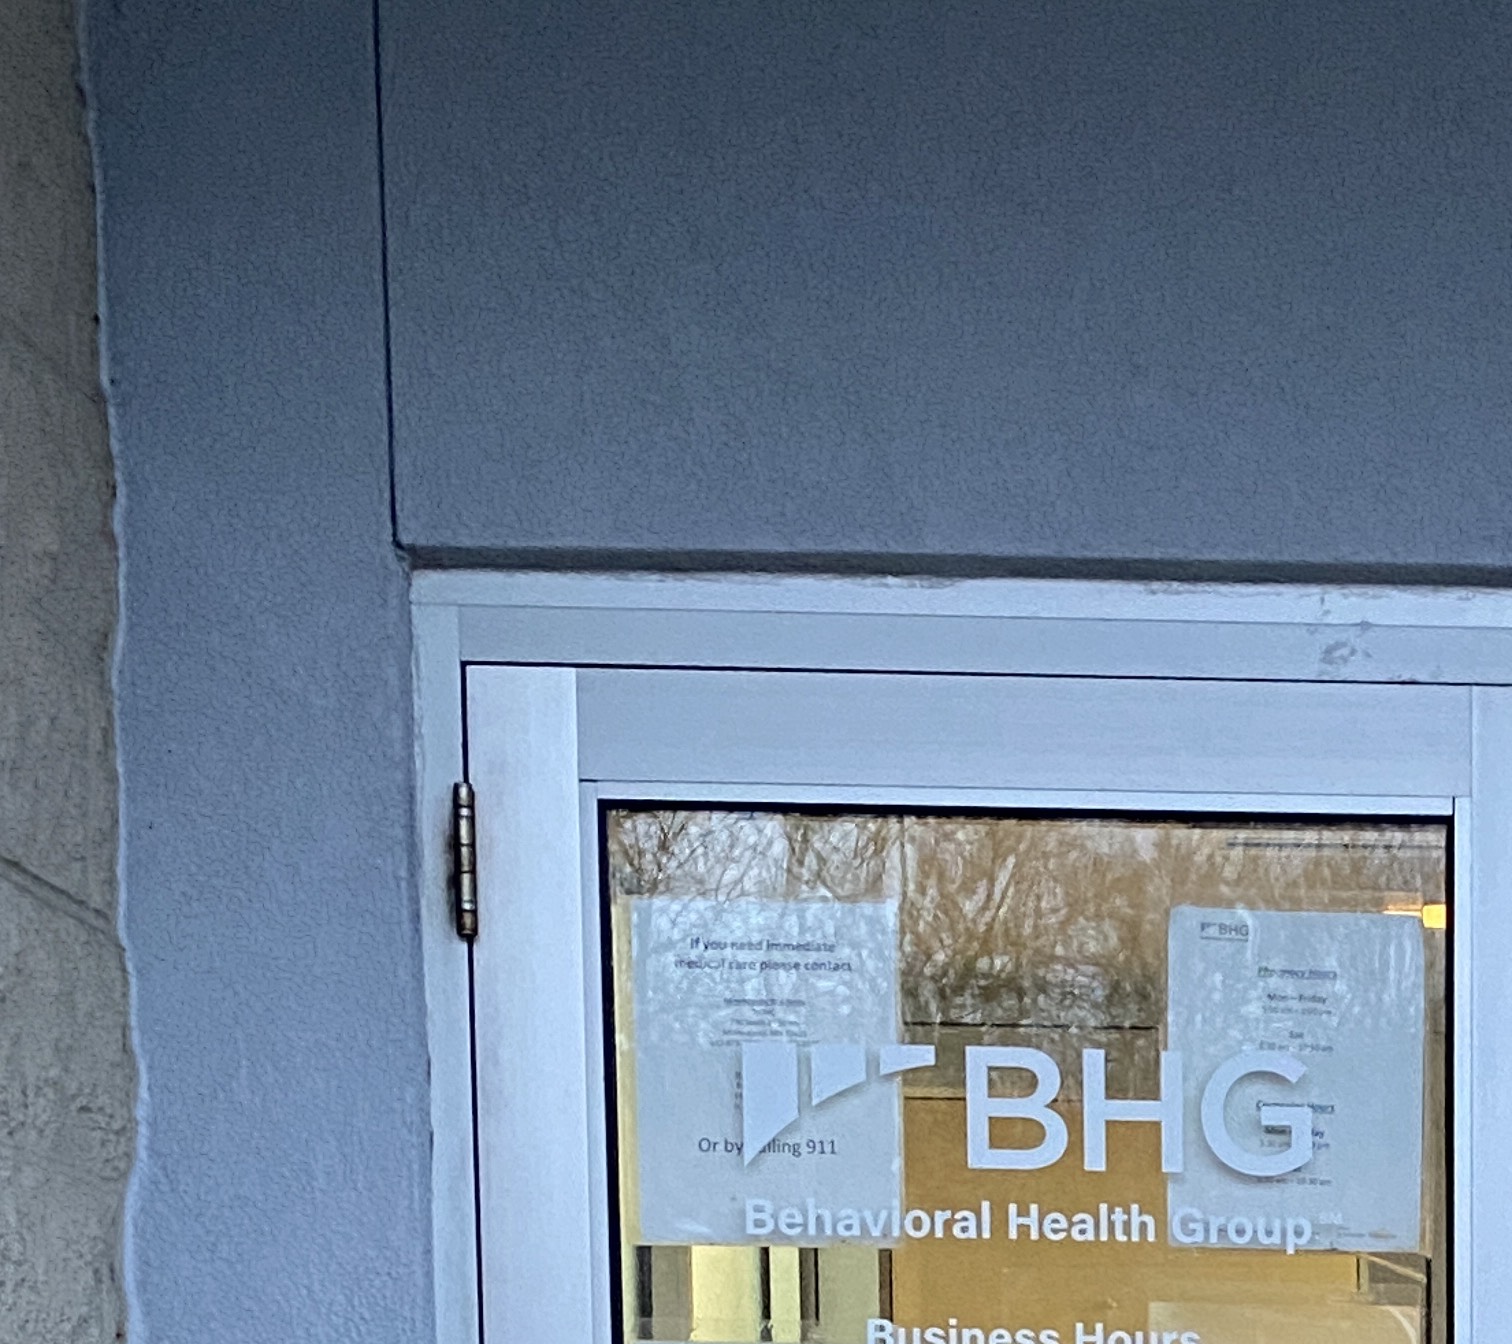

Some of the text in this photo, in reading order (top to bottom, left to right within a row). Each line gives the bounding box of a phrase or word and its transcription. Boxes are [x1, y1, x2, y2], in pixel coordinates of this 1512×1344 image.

[691, 937, 700, 950] If
[702, 939, 726, 951] you
[675, 958, 724, 970] medical
[760, 960, 800, 972] please
[804, 961, 852, 972] contact
[964, 1045, 1313, 1177] BHG
[698, 1138, 837, 1157] Or by alling 911
[744, 1198, 992, 1240] Behavioral
[1008, 1202, 1156, 1243] Health
[1171, 1206, 1312, 1254] Group
